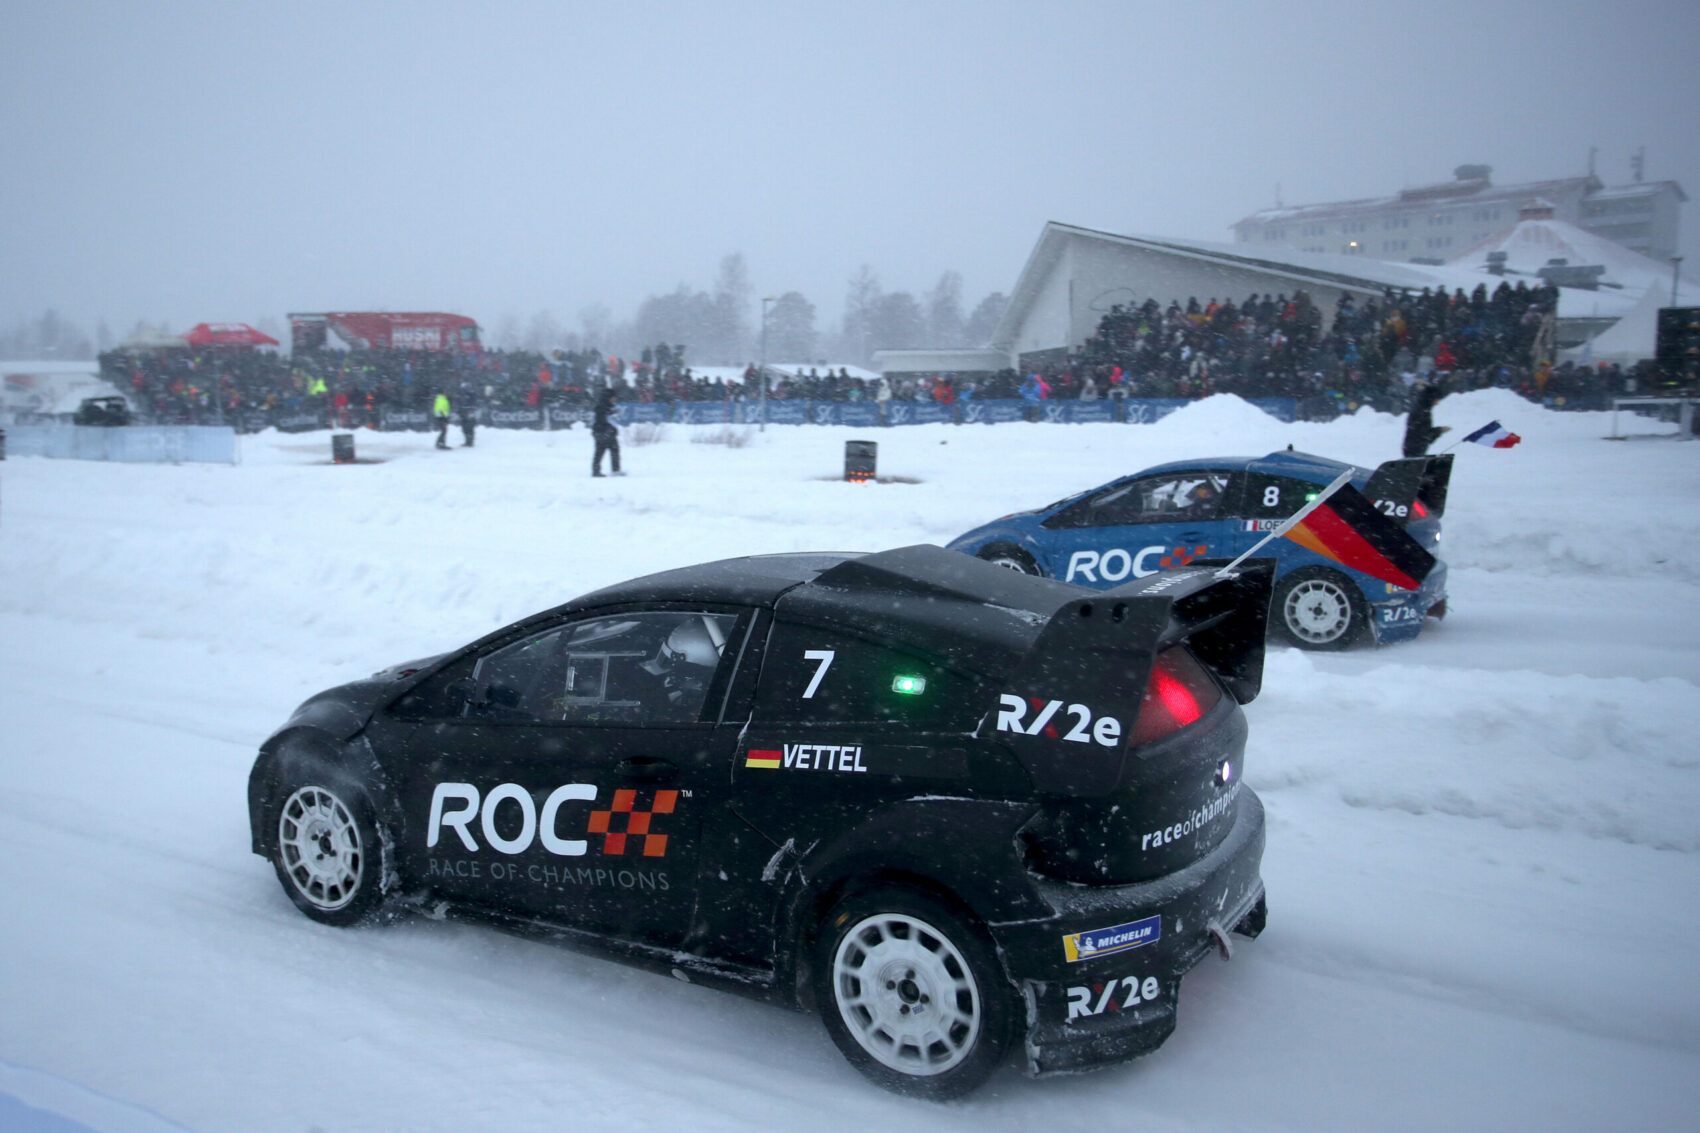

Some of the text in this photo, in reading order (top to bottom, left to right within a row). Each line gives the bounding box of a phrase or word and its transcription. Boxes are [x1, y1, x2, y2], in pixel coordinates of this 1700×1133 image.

[1263, 485, 1280, 507] 8
[1258, 520, 1286, 530] LOE
[1065, 545, 1166, 583] ROC
[802, 649, 835, 699] 7
[782, 743, 867, 773] VETTEL
[426, 782, 598, 857] ROC
[429, 858, 670, 891] RACE OF CHAMPIONS
[1097, 926, 1153, 948] MICHELIN
